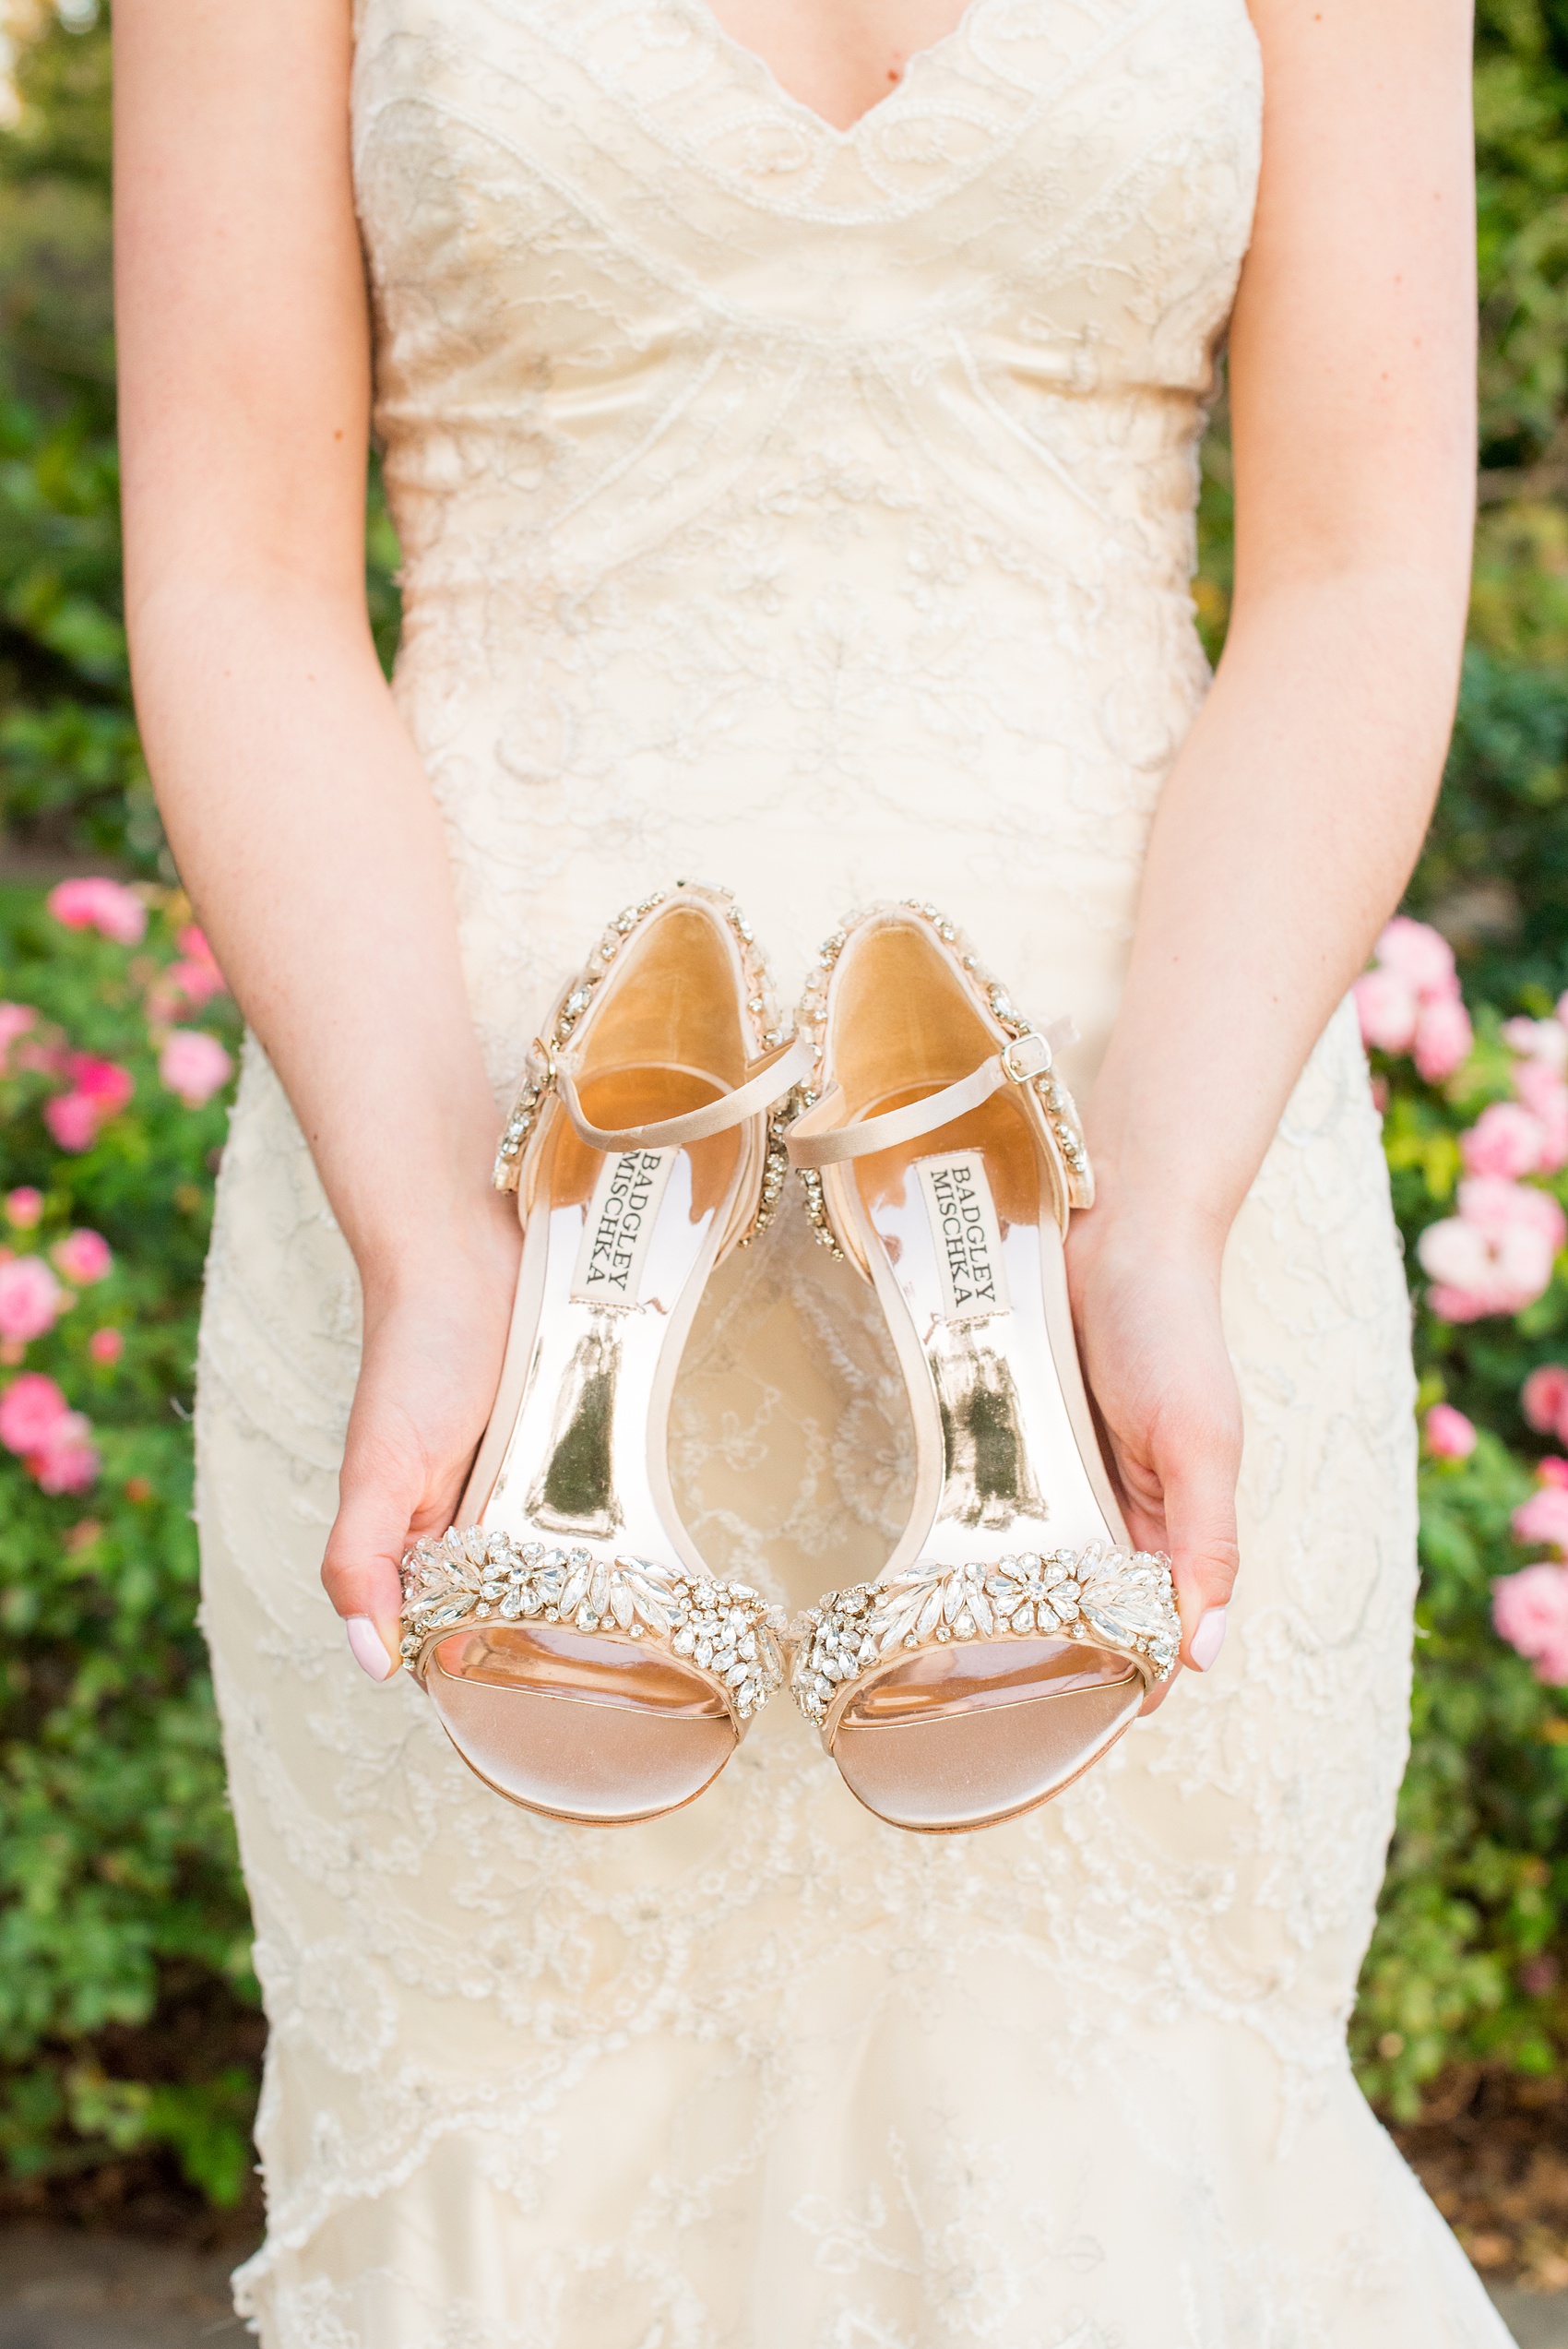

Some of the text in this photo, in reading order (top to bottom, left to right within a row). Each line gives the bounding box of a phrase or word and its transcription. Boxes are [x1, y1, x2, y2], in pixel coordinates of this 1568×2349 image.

[587, 1151, 641, 1284] MISCHKA
[609, 1151, 661, 1291] BADGLEY
[930, 1169, 973, 1308] MISCHKA
[952, 1166, 996, 1303] BADGLEY
